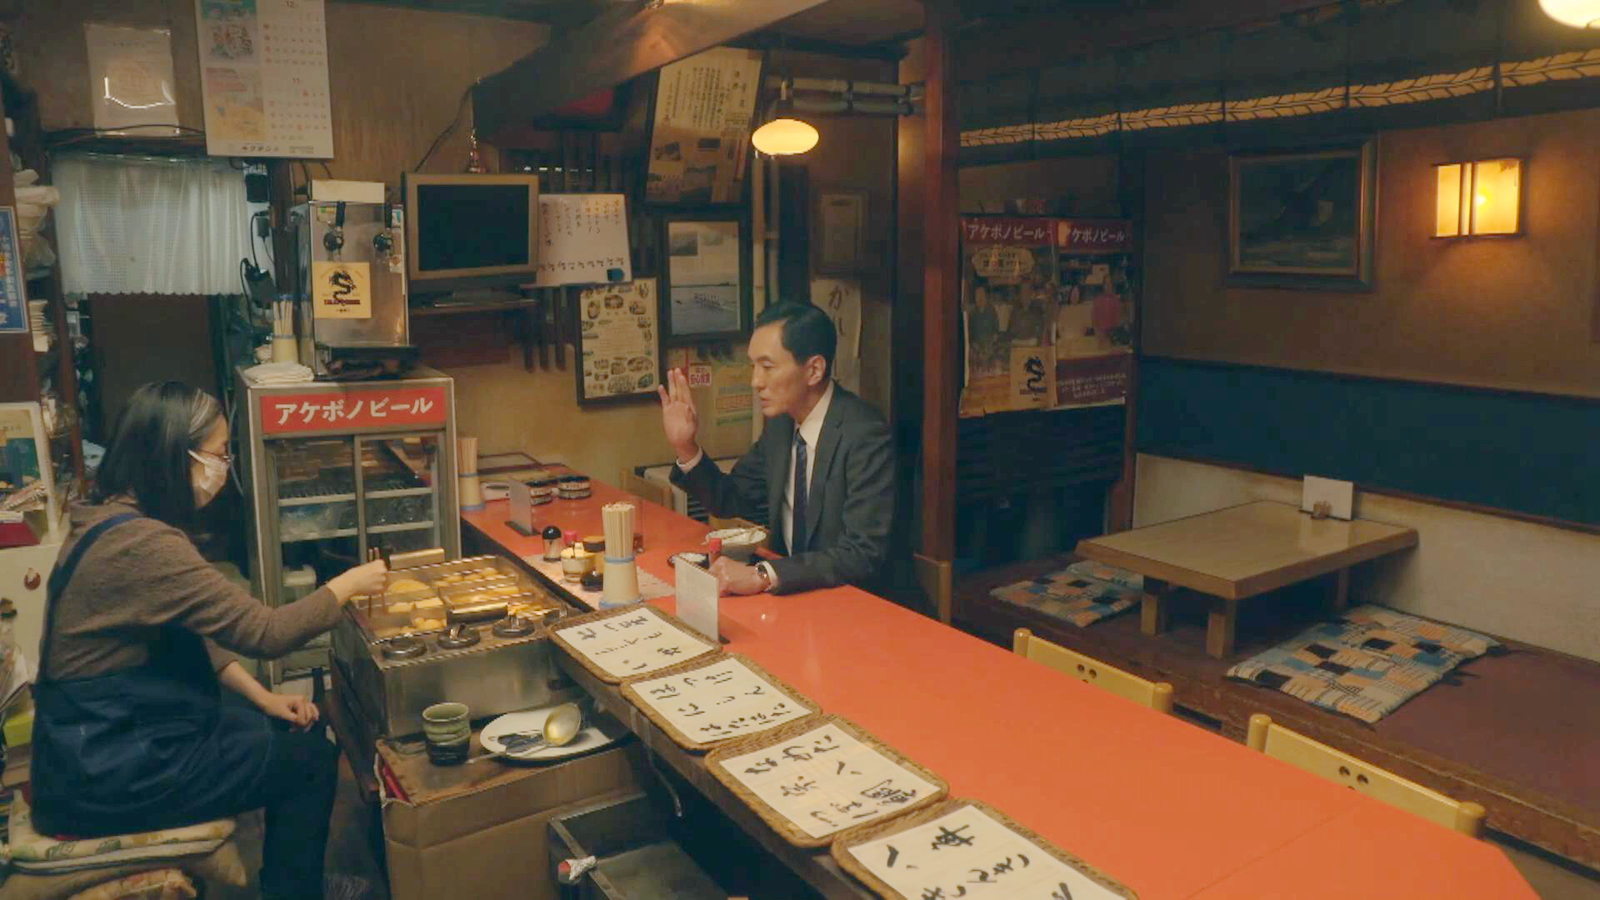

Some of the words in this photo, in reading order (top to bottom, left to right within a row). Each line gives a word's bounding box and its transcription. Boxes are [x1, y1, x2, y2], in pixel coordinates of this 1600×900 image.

[967, 223, 1045, 240] アケボノビール
[1066, 227, 1125, 243] ケボノビール
[275, 397, 434, 426] アケボノビール
[678, 686, 765, 717] にしん
[744, 735, 840, 774] なめた
[780, 760, 863, 796] 宗八
[810, 779, 916, 827] つぼ鯛
